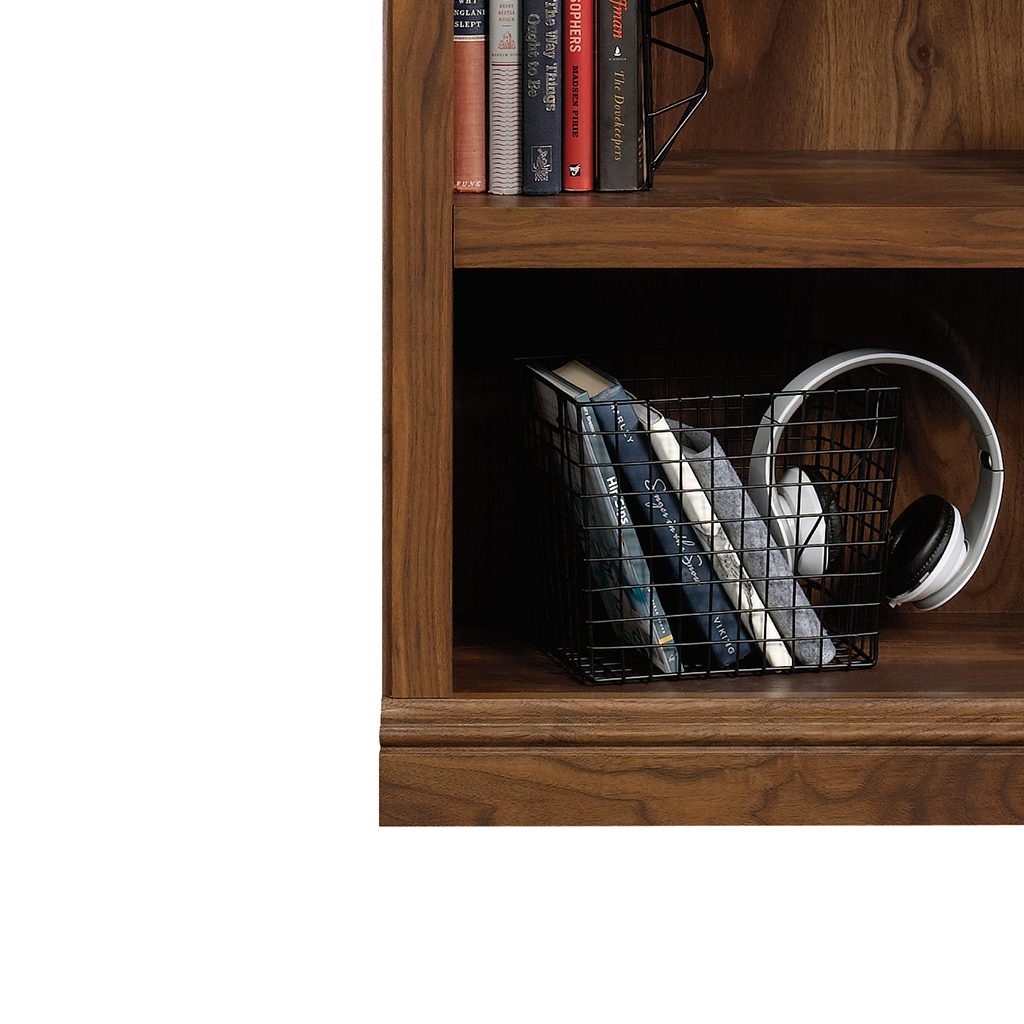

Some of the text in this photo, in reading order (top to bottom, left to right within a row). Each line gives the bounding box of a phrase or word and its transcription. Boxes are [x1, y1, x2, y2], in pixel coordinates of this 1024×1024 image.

[525, 13, 541, 98] Ought to Be
[542, 29, 559, 60] Way
[542, 62, 558, 112] Things
[571, 65, 579, 139] MADSEN PIRIE
[613, 70, 625, 92] The
[611, 94, 625, 163] Dovekeepers
